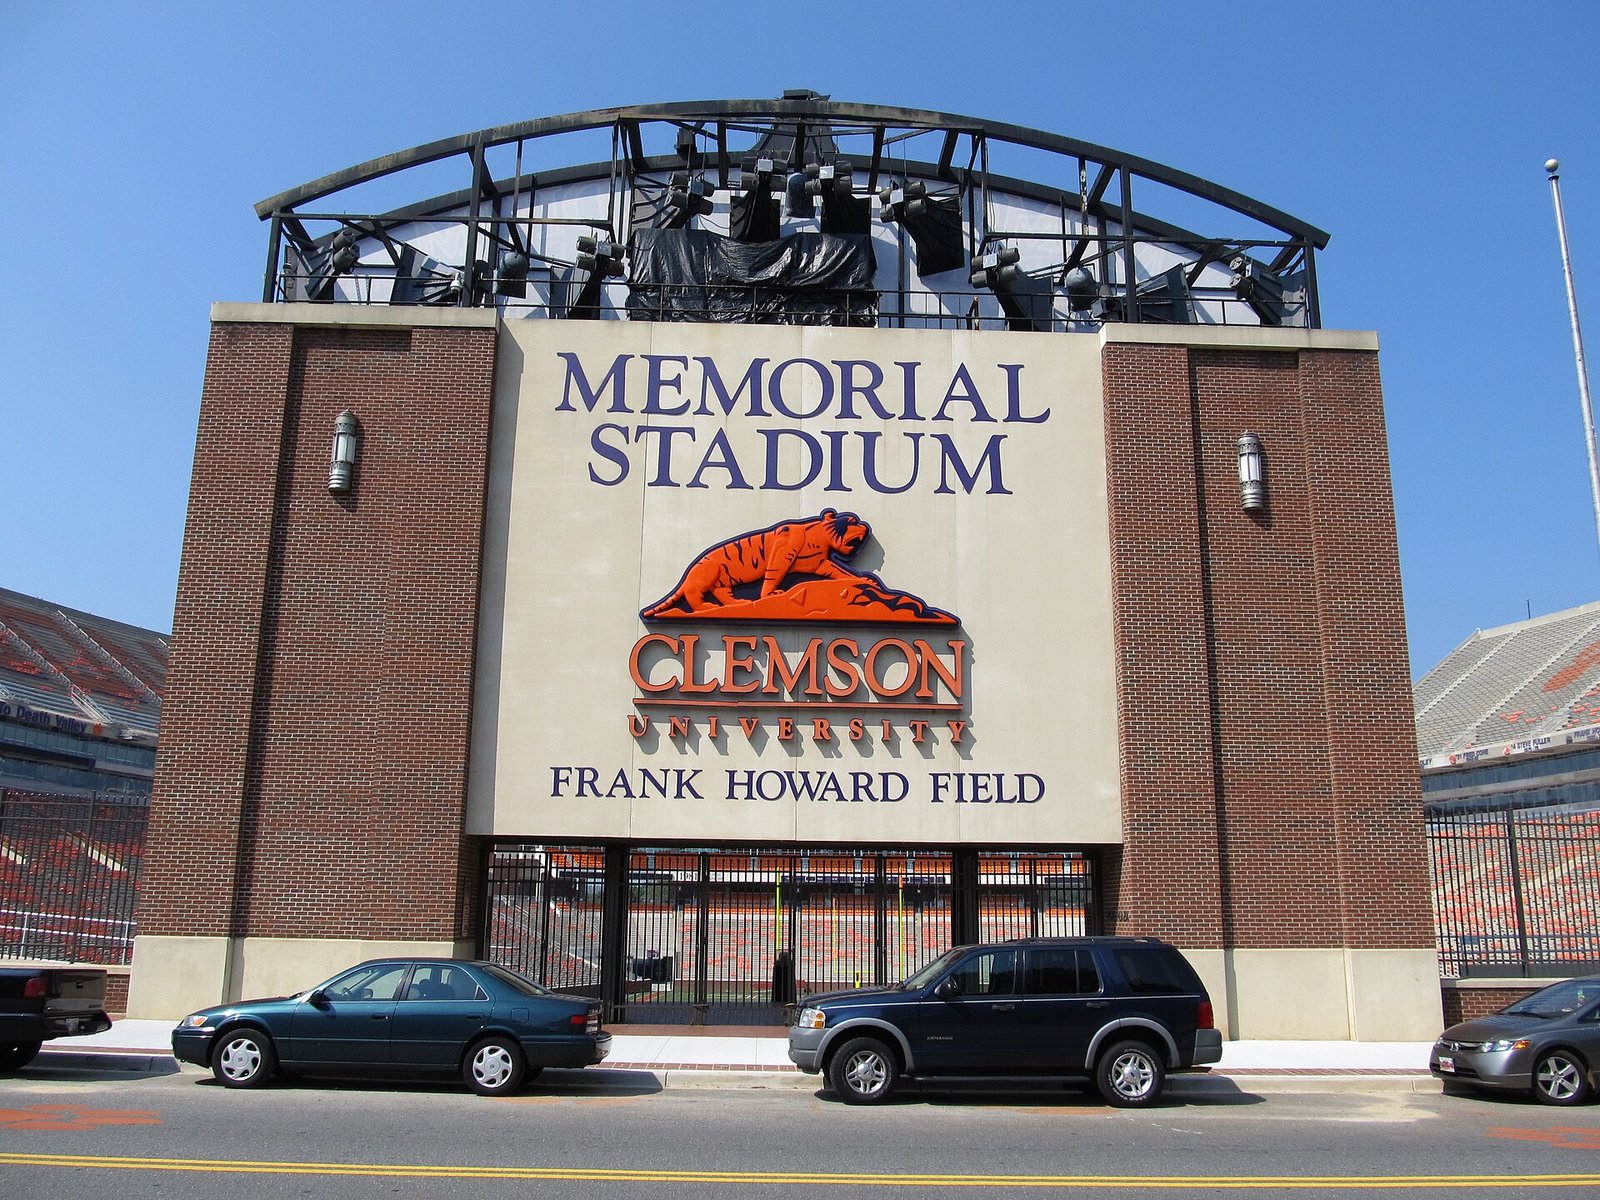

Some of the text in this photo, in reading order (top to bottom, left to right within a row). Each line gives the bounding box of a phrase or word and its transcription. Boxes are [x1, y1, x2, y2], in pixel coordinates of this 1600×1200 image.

[555, 352, 1050, 422] MEMORIAL
[588, 424, 1013, 495] STADIUM
[628, 633, 966, 699] CLEMSON
[16, 705, 50, 724] Death
[56, 714, 87, 732] Valley
[627, 714, 968, 742] UNIVERSITY
[549, 767, 1046, 803] FRANK HOWARD FIELD
